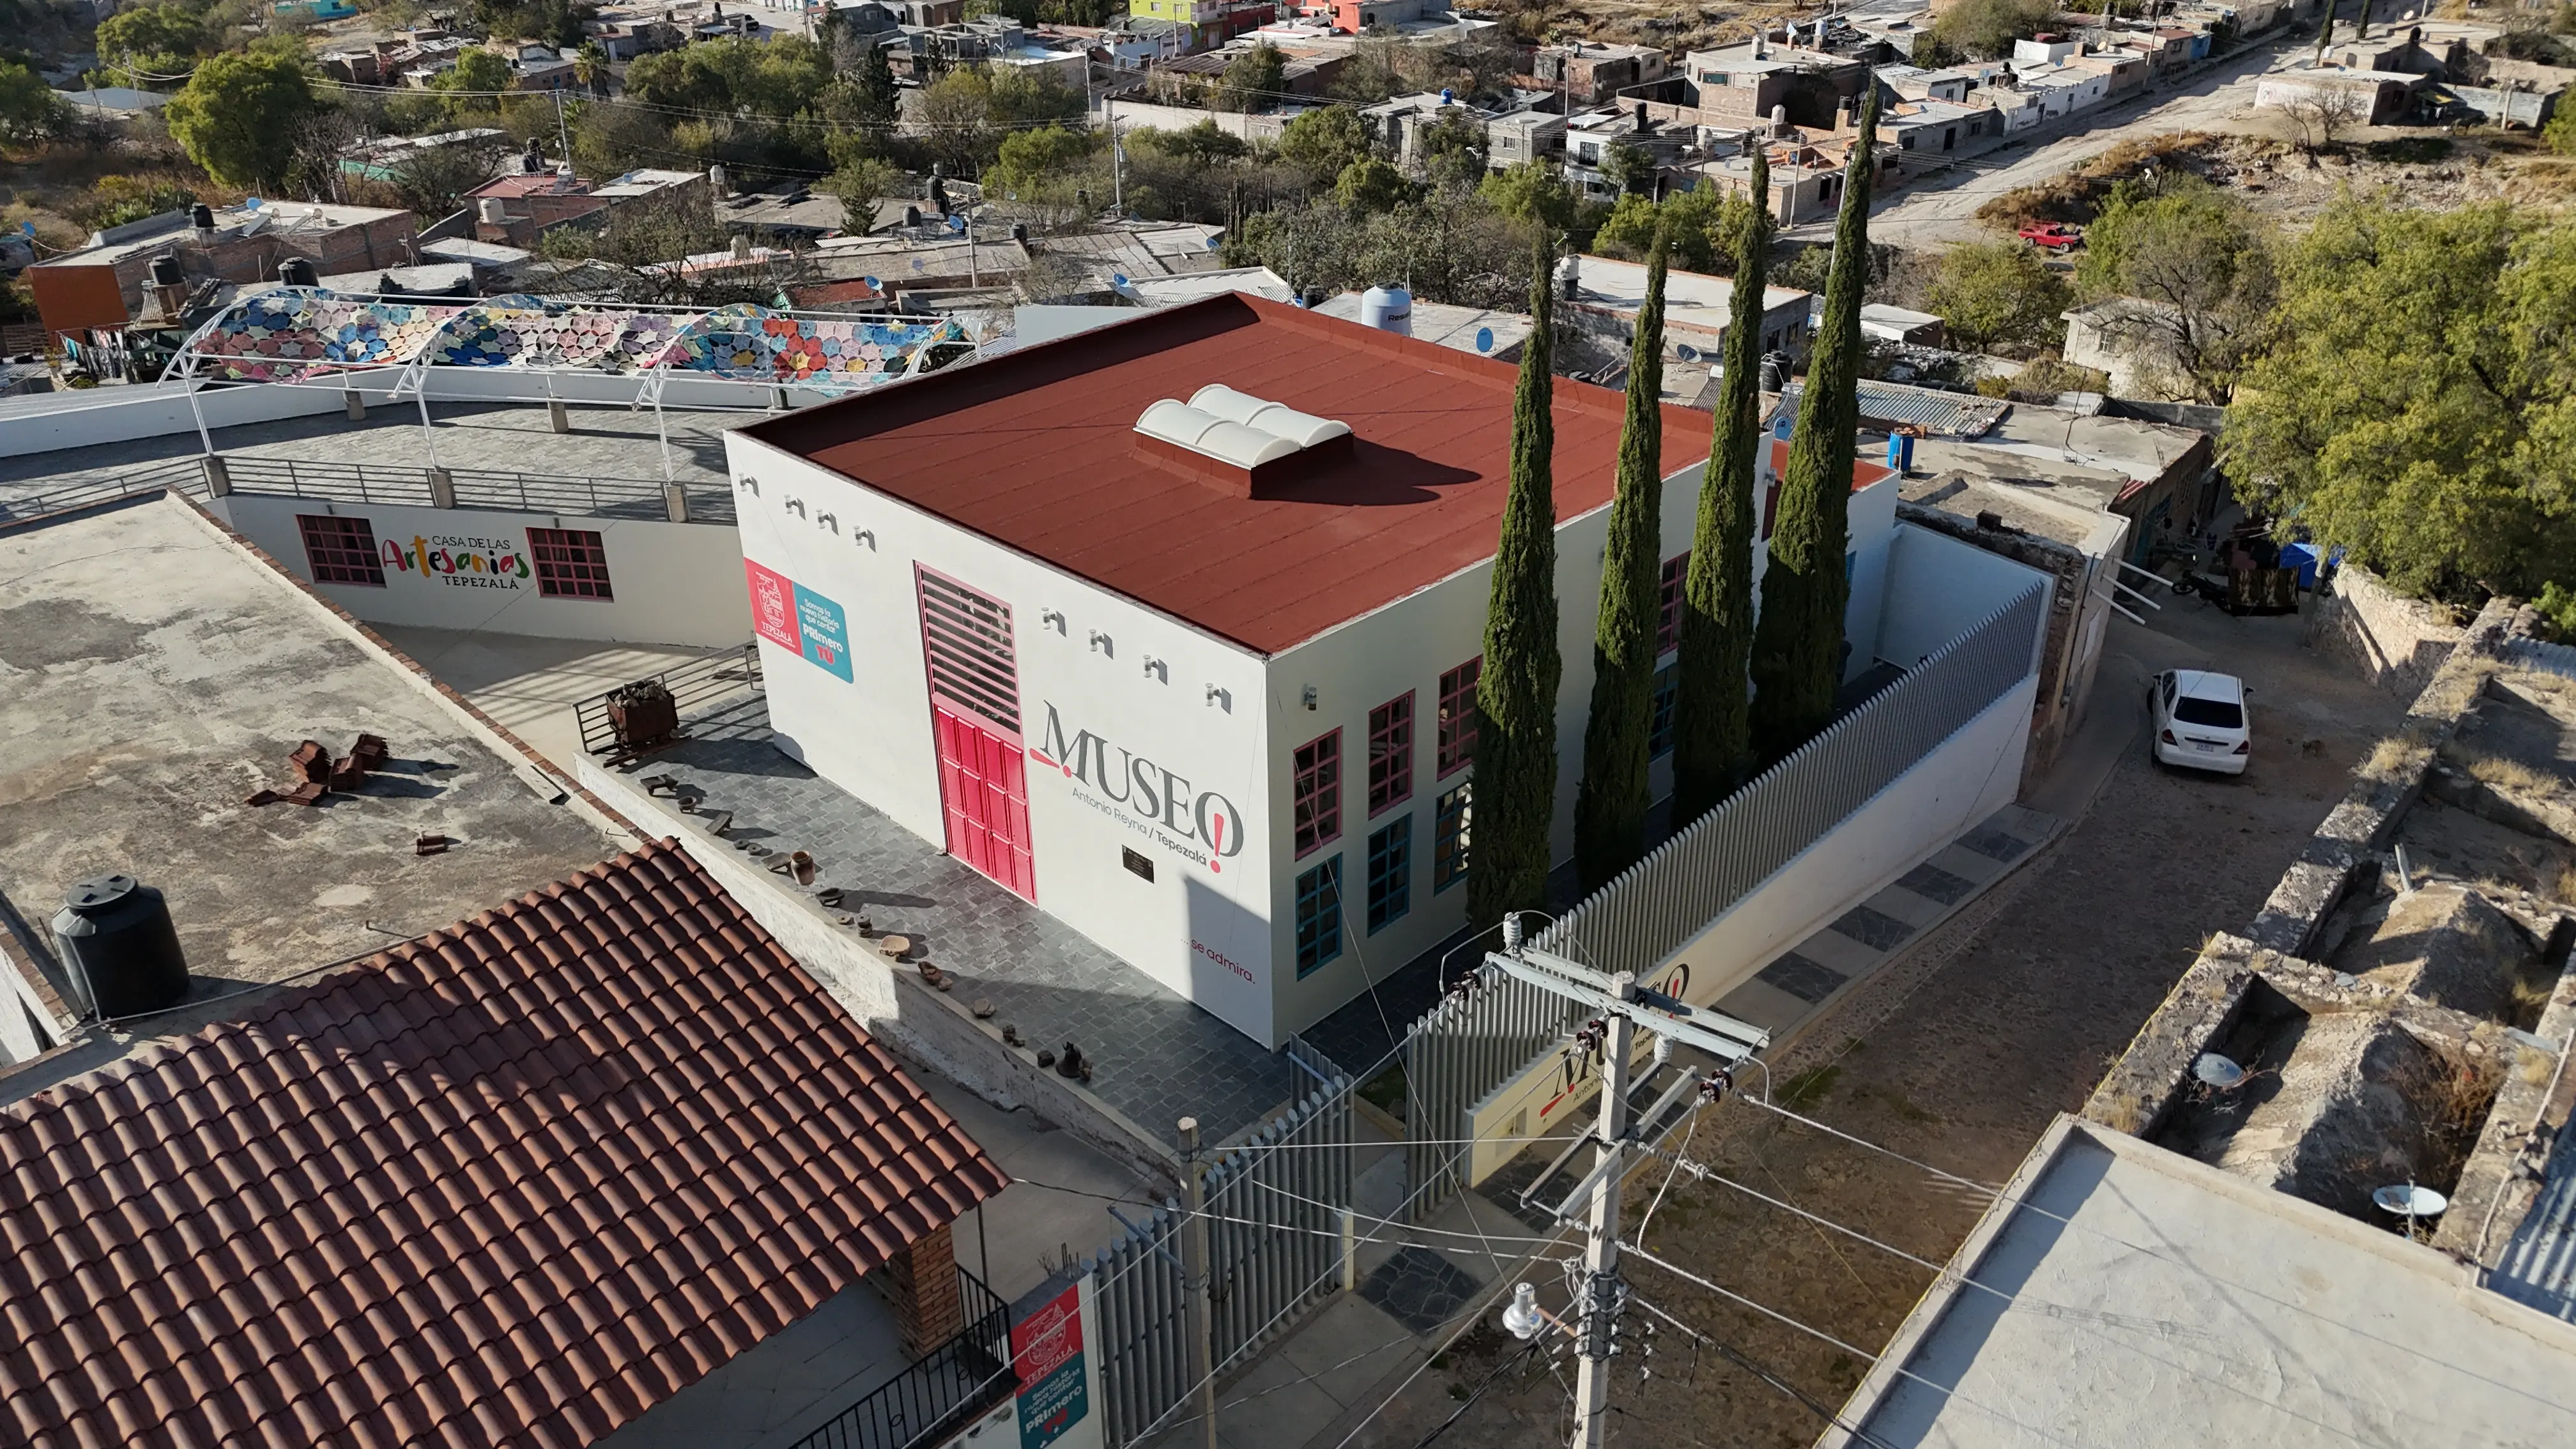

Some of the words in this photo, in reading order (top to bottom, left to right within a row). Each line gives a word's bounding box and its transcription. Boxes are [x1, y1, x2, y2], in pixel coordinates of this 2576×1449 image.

[383, 534, 530, 579] Artesanias
[432, 535, 466, 548] CASA
[468, 537, 486, 548] DE
[486, 539, 510, 549] LAS
[442, 576, 519, 590] TEPEZALÁ
[1039, 700, 1245, 857] MUSEO
[1072, 787, 1112, 815] Antonio
[1114, 808, 1147, 835] Reyna
[1156, 830, 1207, 866] Tepezalá
[1206, 948, 1256, 985] admira.
